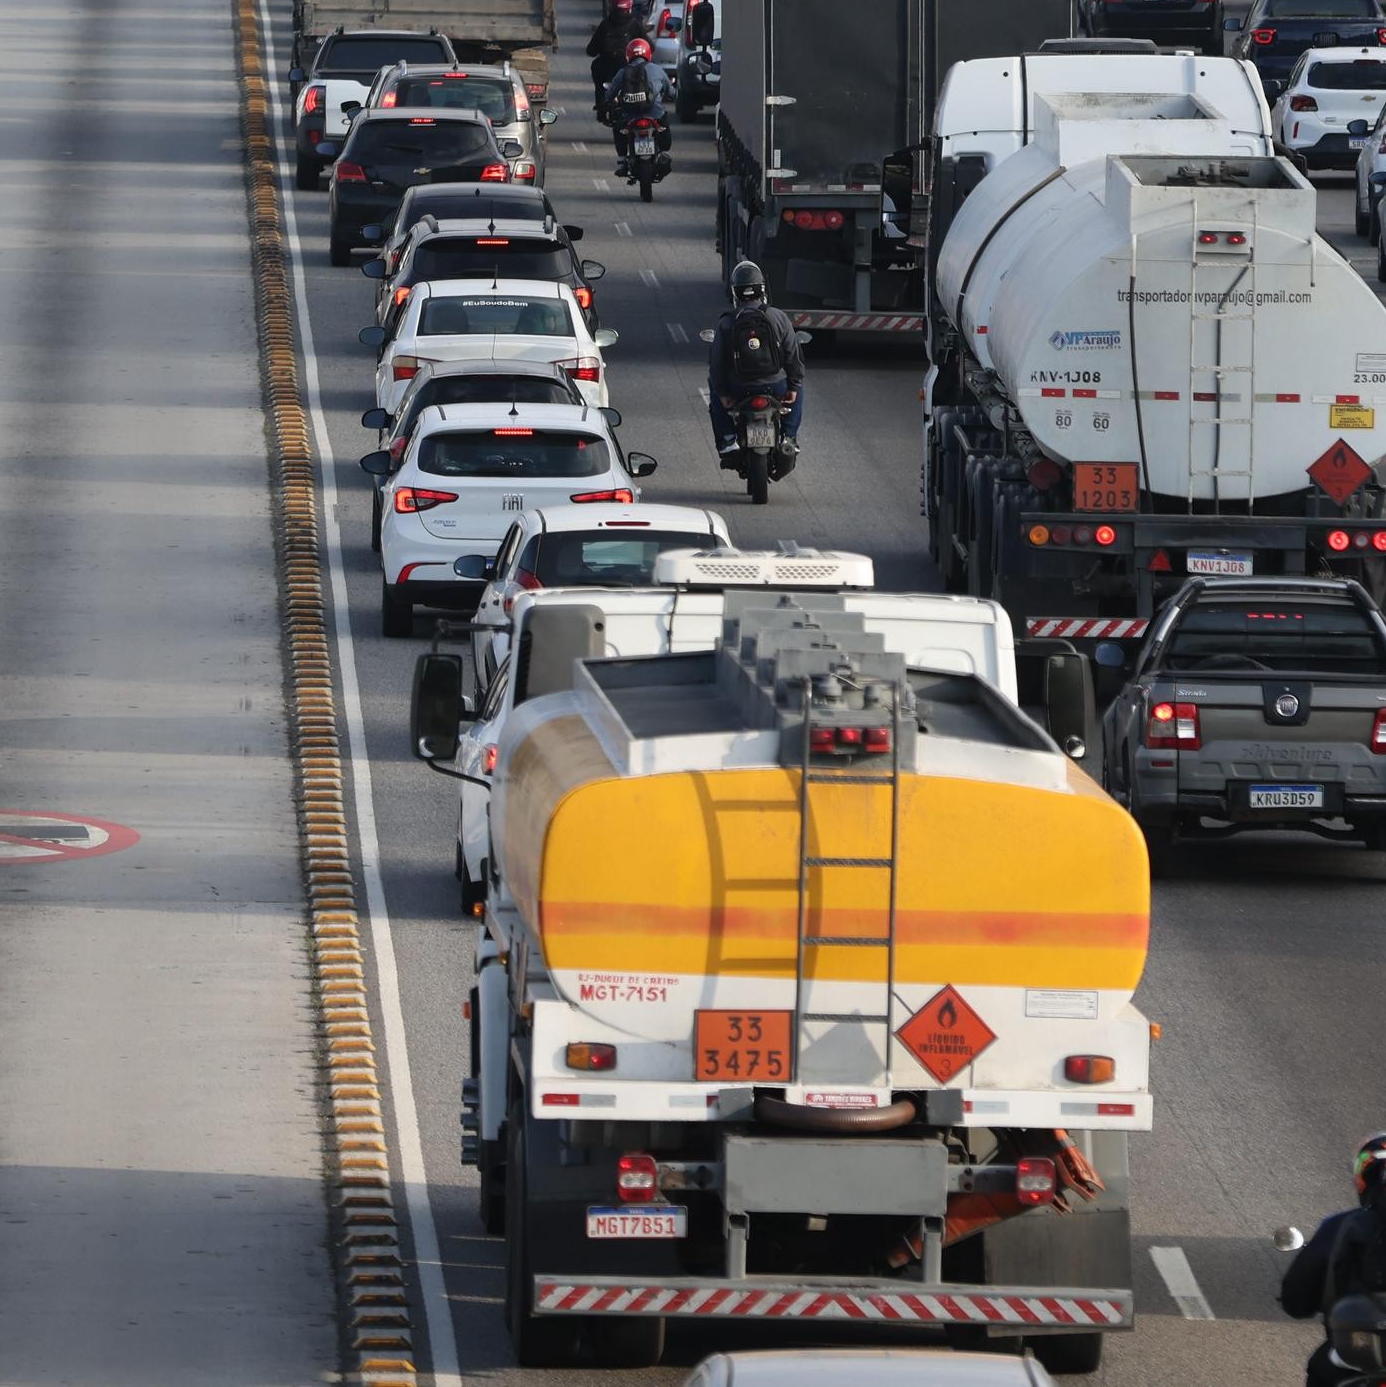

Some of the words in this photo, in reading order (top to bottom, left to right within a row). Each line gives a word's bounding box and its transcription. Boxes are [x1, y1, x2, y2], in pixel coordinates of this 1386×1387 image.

[1083, 335, 1121, 347] Araujo
[1055, 415, 1072, 427] 80
[1093, 417, 1110, 430] 60
[1092, 467, 1117, 485] 33
[502, 493, 524, 511] FIAT
[1083, 490, 1131, 508] 1203
[1192, 560, 1245, 574] KNV1J08
[1256, 792, 1315, 807] KRU3D59
[727, 1016, 763, 1042] 33
[704, 1050, 783, 1076] 3475
[940, 1059, 952, 1077] 3
[596, 1217, 676, 1235] MGT7B51
